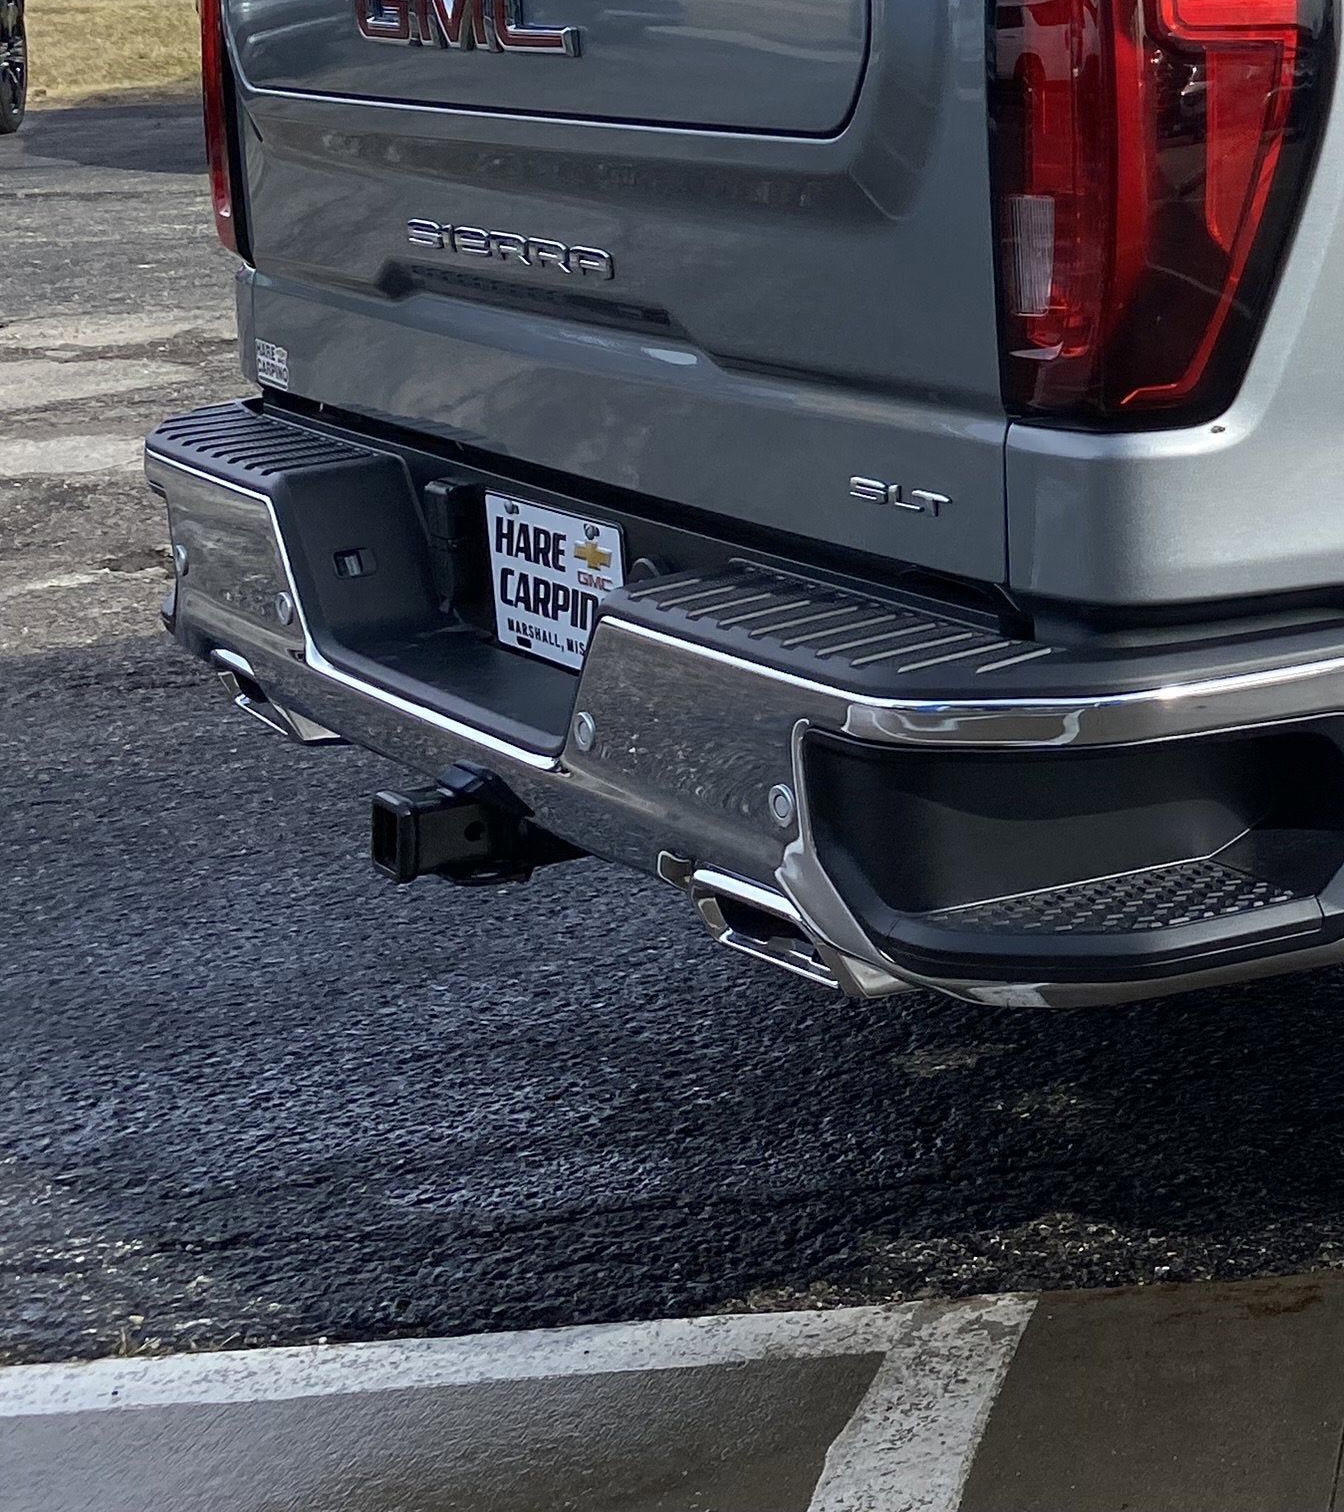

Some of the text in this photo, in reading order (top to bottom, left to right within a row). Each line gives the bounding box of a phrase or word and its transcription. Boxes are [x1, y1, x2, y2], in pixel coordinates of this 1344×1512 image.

[406, 217, 615, 280] SIERRA
[849, 474, 953, 518] SLT
[495, 516, 567, 573] HARE
[500, 567, 600, 630] CARPIN
[576, 570, 613, 592] GMC
